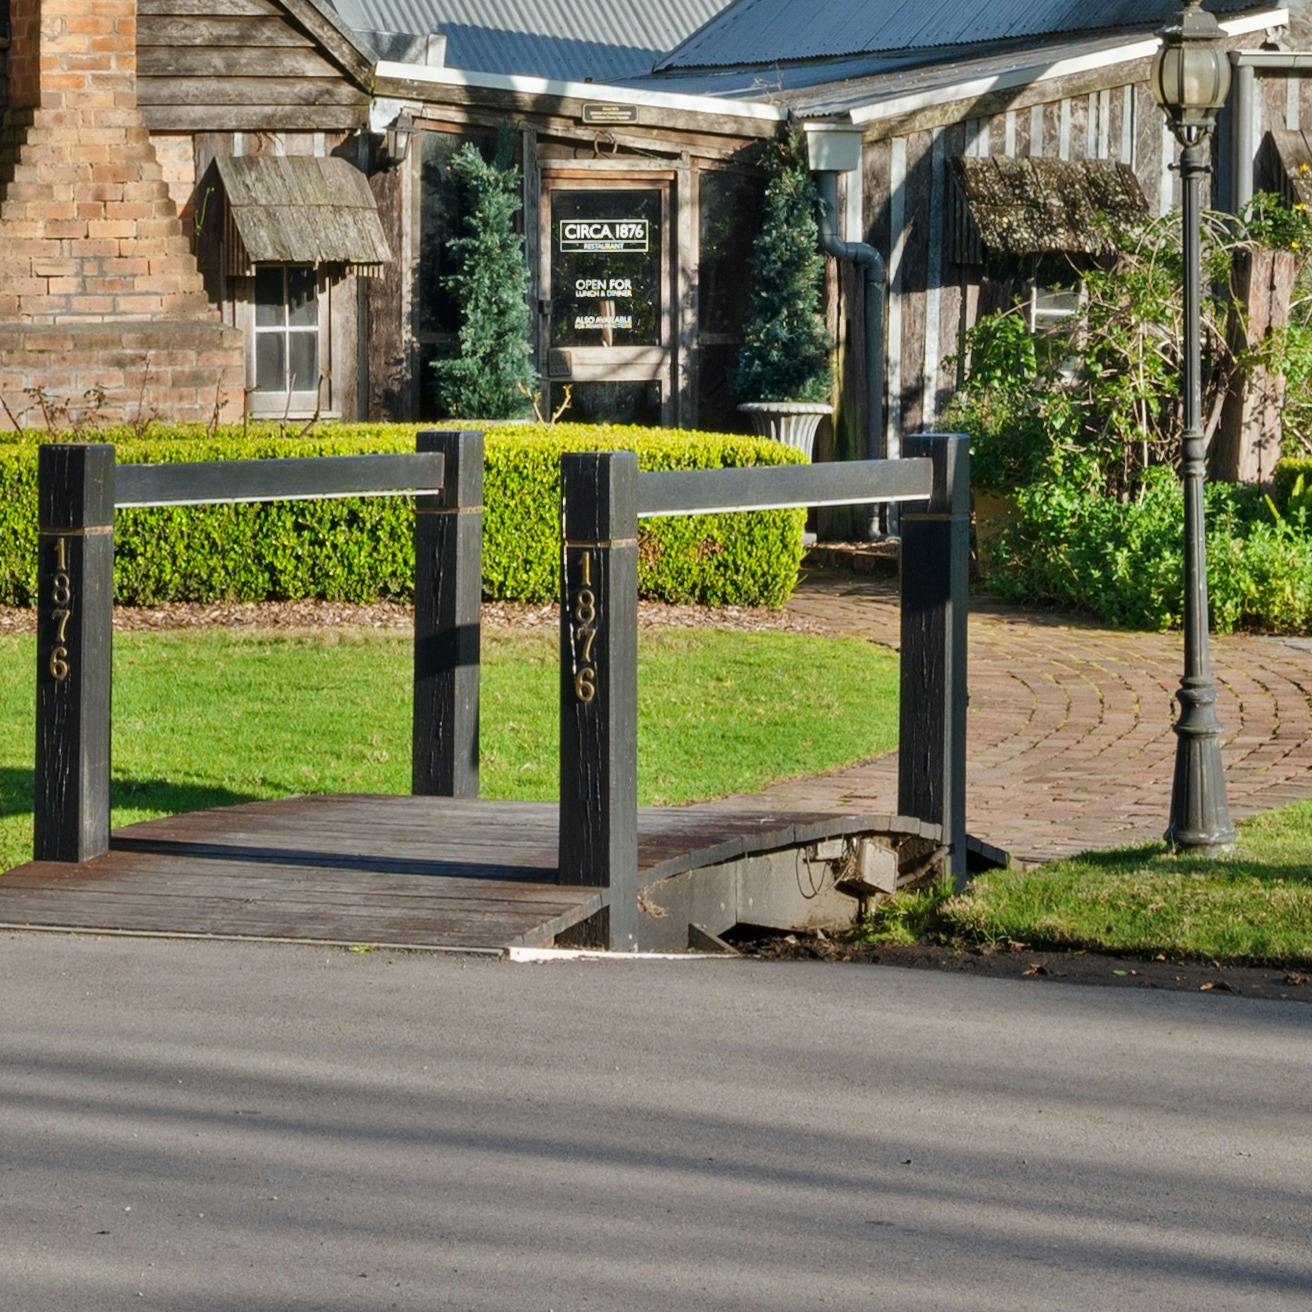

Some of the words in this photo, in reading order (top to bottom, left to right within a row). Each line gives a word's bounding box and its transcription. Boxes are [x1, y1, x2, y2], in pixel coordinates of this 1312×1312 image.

[564, 223, 613, 239] CIRCA
[615, 223, 645, 239] 1876
[583, 241, 624, 250] RESTAURANT
[575, 279, 607, 290] OPEN
[609, 279, 632, 290] FOR
[575, 290, 600, 298] LUNCH
[606, 290, 633, 298] DINNER
[49, 537, 71, 681] 1876
[575, 551, 597, 704] 1876
